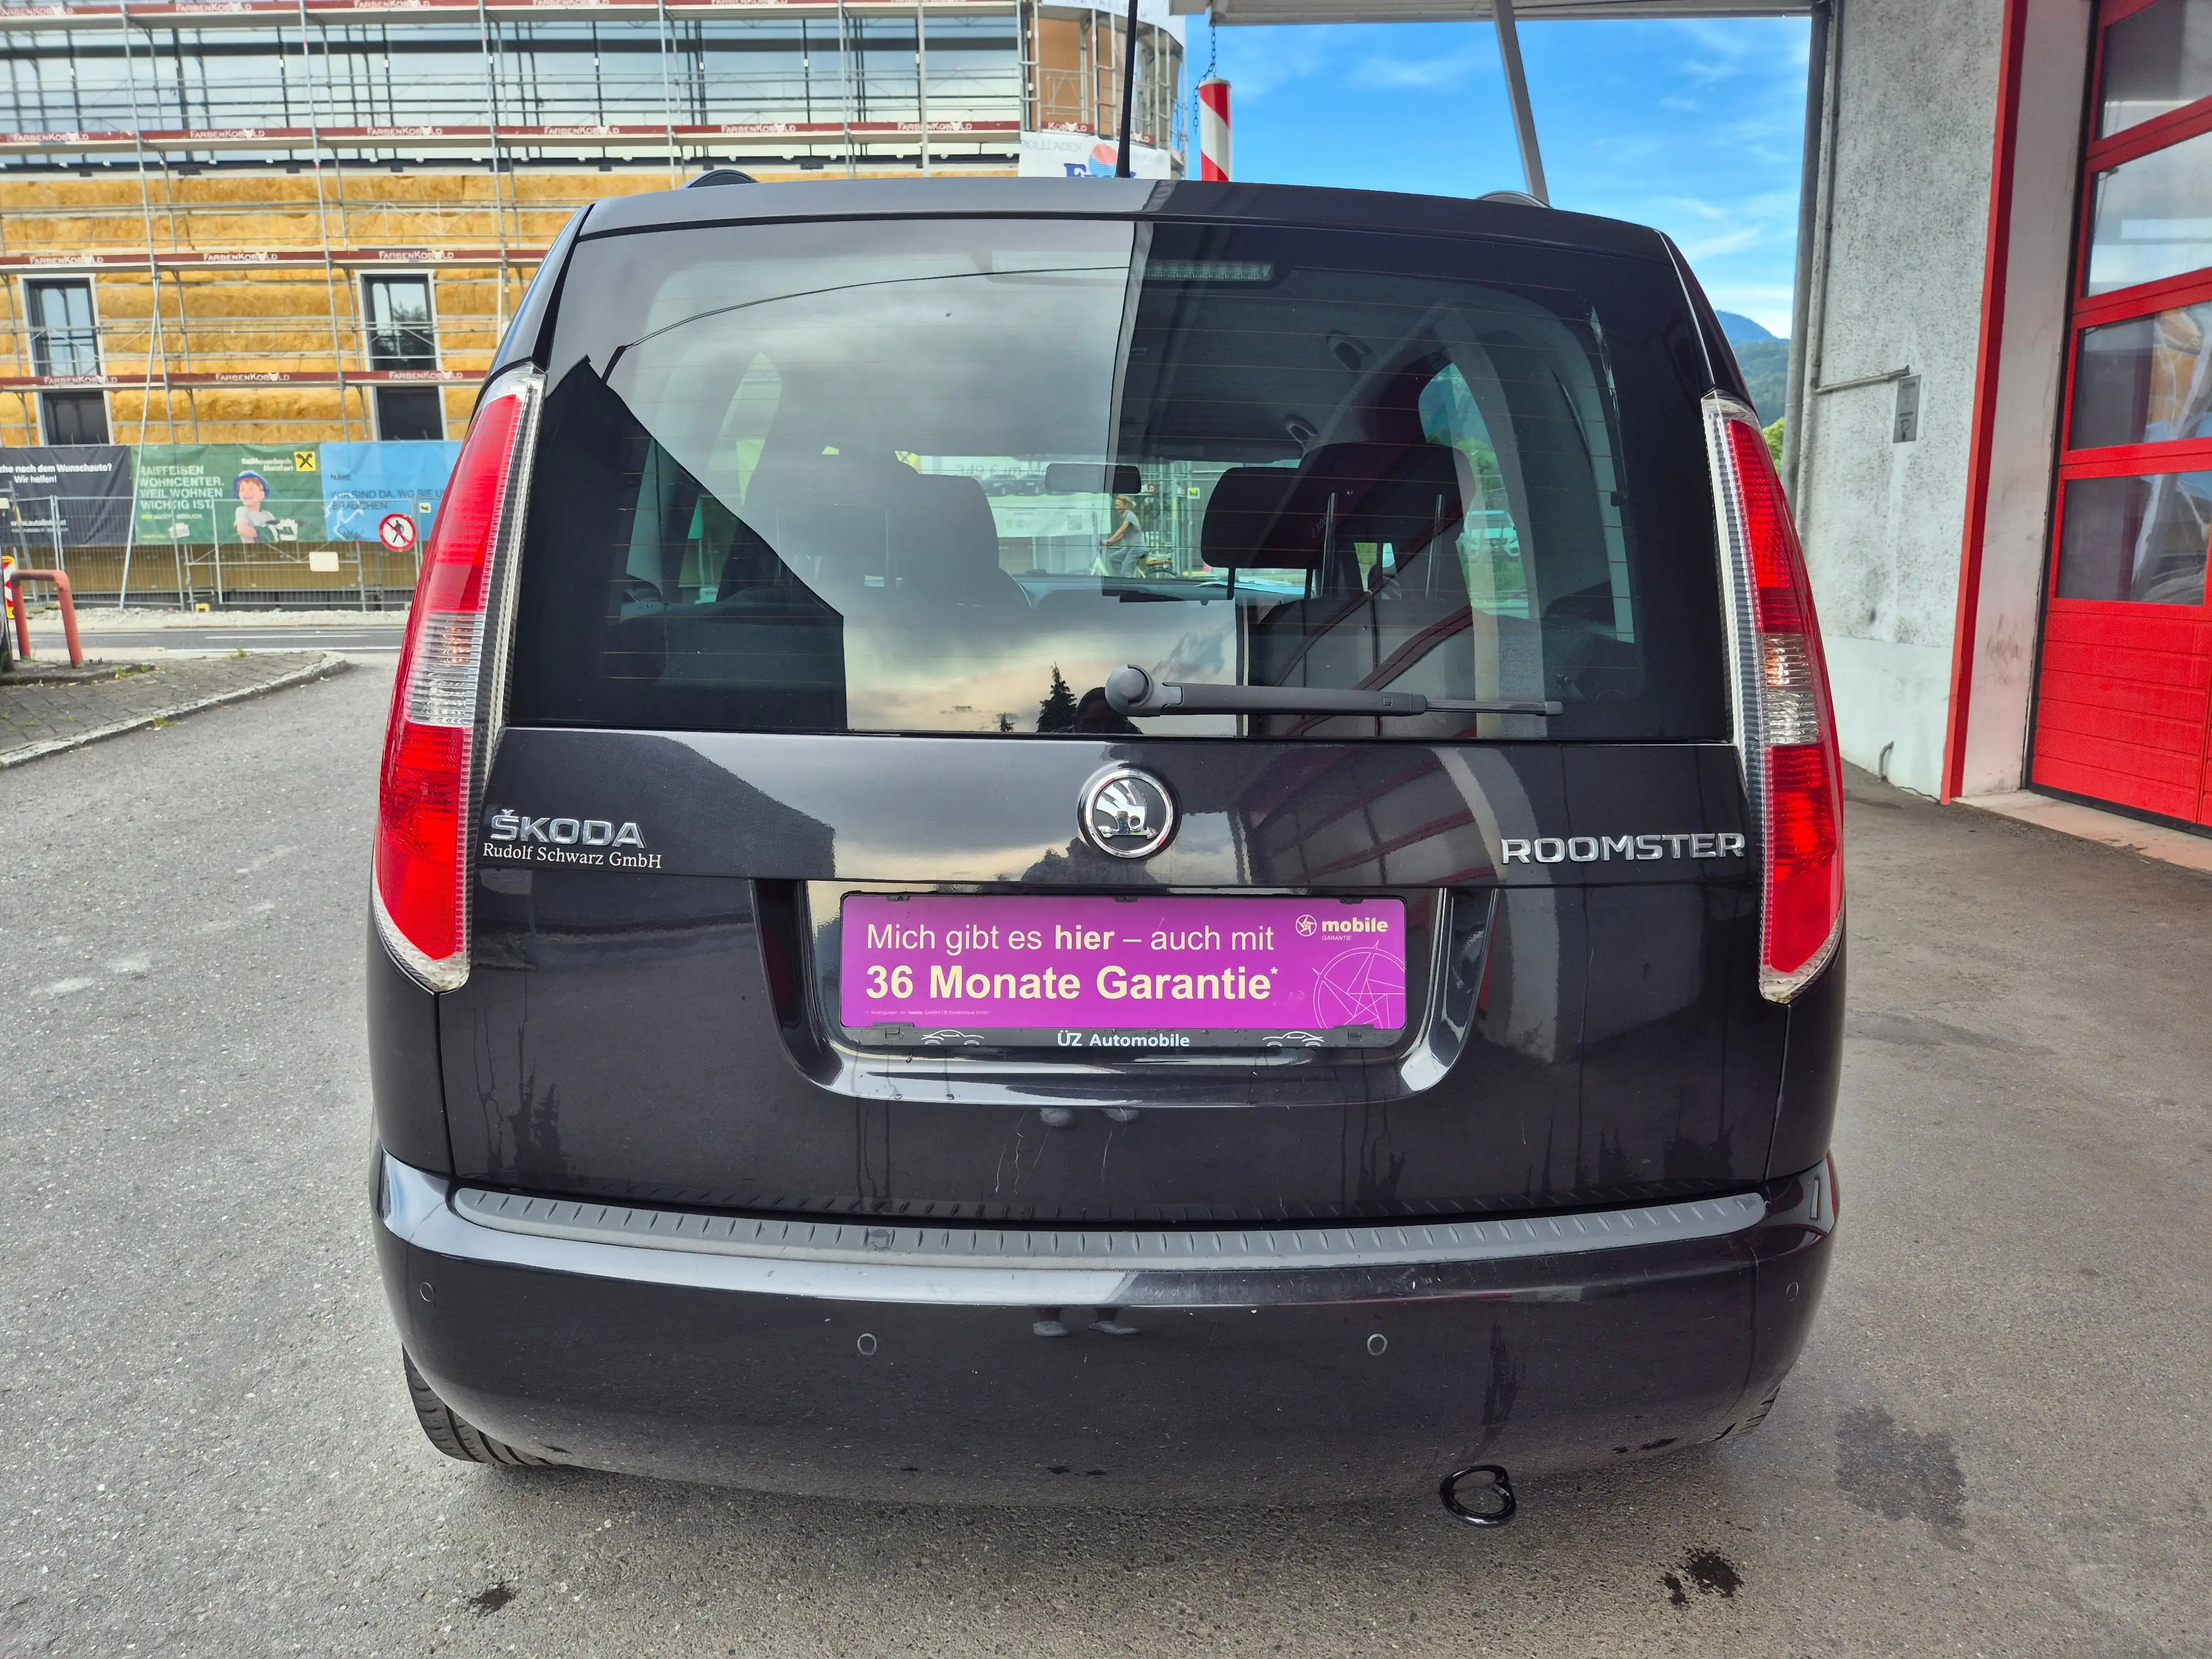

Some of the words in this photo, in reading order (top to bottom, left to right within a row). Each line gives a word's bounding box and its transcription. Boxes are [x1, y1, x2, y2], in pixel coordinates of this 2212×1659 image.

[30, 255, 103, 264] FARBENKOBLD
[203, 252, 278, 262] FARBENKOBLD
[378, 251, 454, 259] FARBENKOBLD
[44, 375, 117, 384] FARBENKOBLD
[215, 372, 290, 382] FARBENKOBLD
[389, 370, 463, 380] FARBENKOBLD
[16, 464, 36, 473] nach
[37, 463, 56, 473] dem
[56, 463, 112, 473] Wunschauto?
[141, 464, 204, 476] RAIFFEISEN
[14, 475, 29, 484] Wir
[30, 474, 57, 484] helfen!
[139, 476, 225, 487] WOHNCENTER.
[140, 488, 167, 498] WEIL
[170, 487, 223, 499] WOHNEN
[351, 490, 377, 499] SIND
[490, 809, 646, 849] ŠKODA
[1500, 832, 1745, 864] ROOMSTER
[483, 843, 534, 861] Rudolf
[537, 847, 604, 865] Schwarz
[609, 852, 662, 869] GmbH
[1321, 917, 1389, 933] mobile
[867, 923, 935, 949] Mich
[946, 923, 999, 956] gibt
[1008, 932, 1042, 950] es
[1055, 924, 1115, 950] hier
[1150, 925, 1220, 951] auch
[1231, 925, 1274, 951] mit
[866, 965, 913, 999] 36
[930, 965, 1081, 999] Monate
[1057, 1030, 1082, 1047] ÜZ
[1089, 1033, 1190, 1047] Automobile
